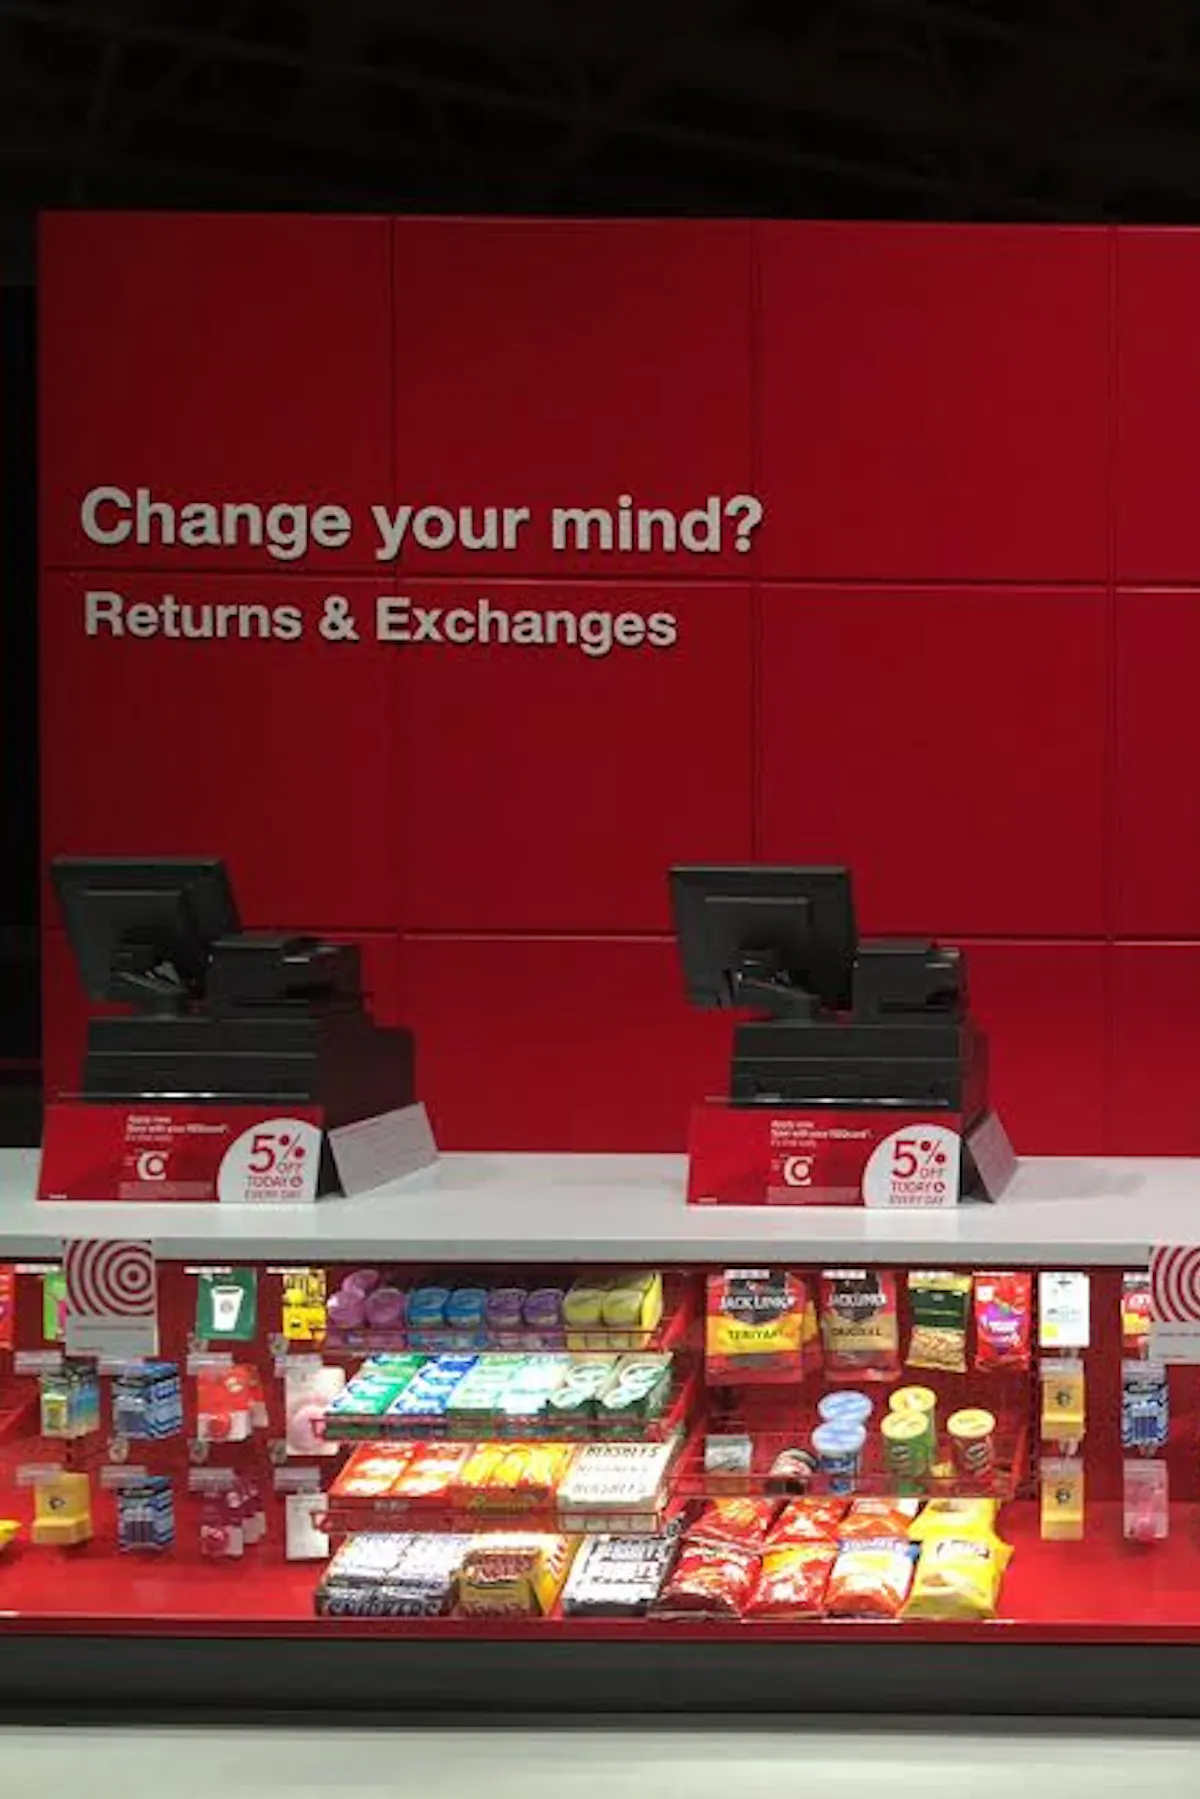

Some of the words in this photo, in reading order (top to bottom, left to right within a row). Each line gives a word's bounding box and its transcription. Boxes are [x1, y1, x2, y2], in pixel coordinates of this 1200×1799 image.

[81, 486, 352, 559] Change
[373, 502, 530, 560] your
[551, 494, 763, 553] mind?
[84, 590, 301, 640] Returns
[318, 596, 359, 641] &
[376, 597, 677, 656] Exchanges
[249, 1132, 306, 1173] 5%
[892, 1140, 946, 1179] 5%
